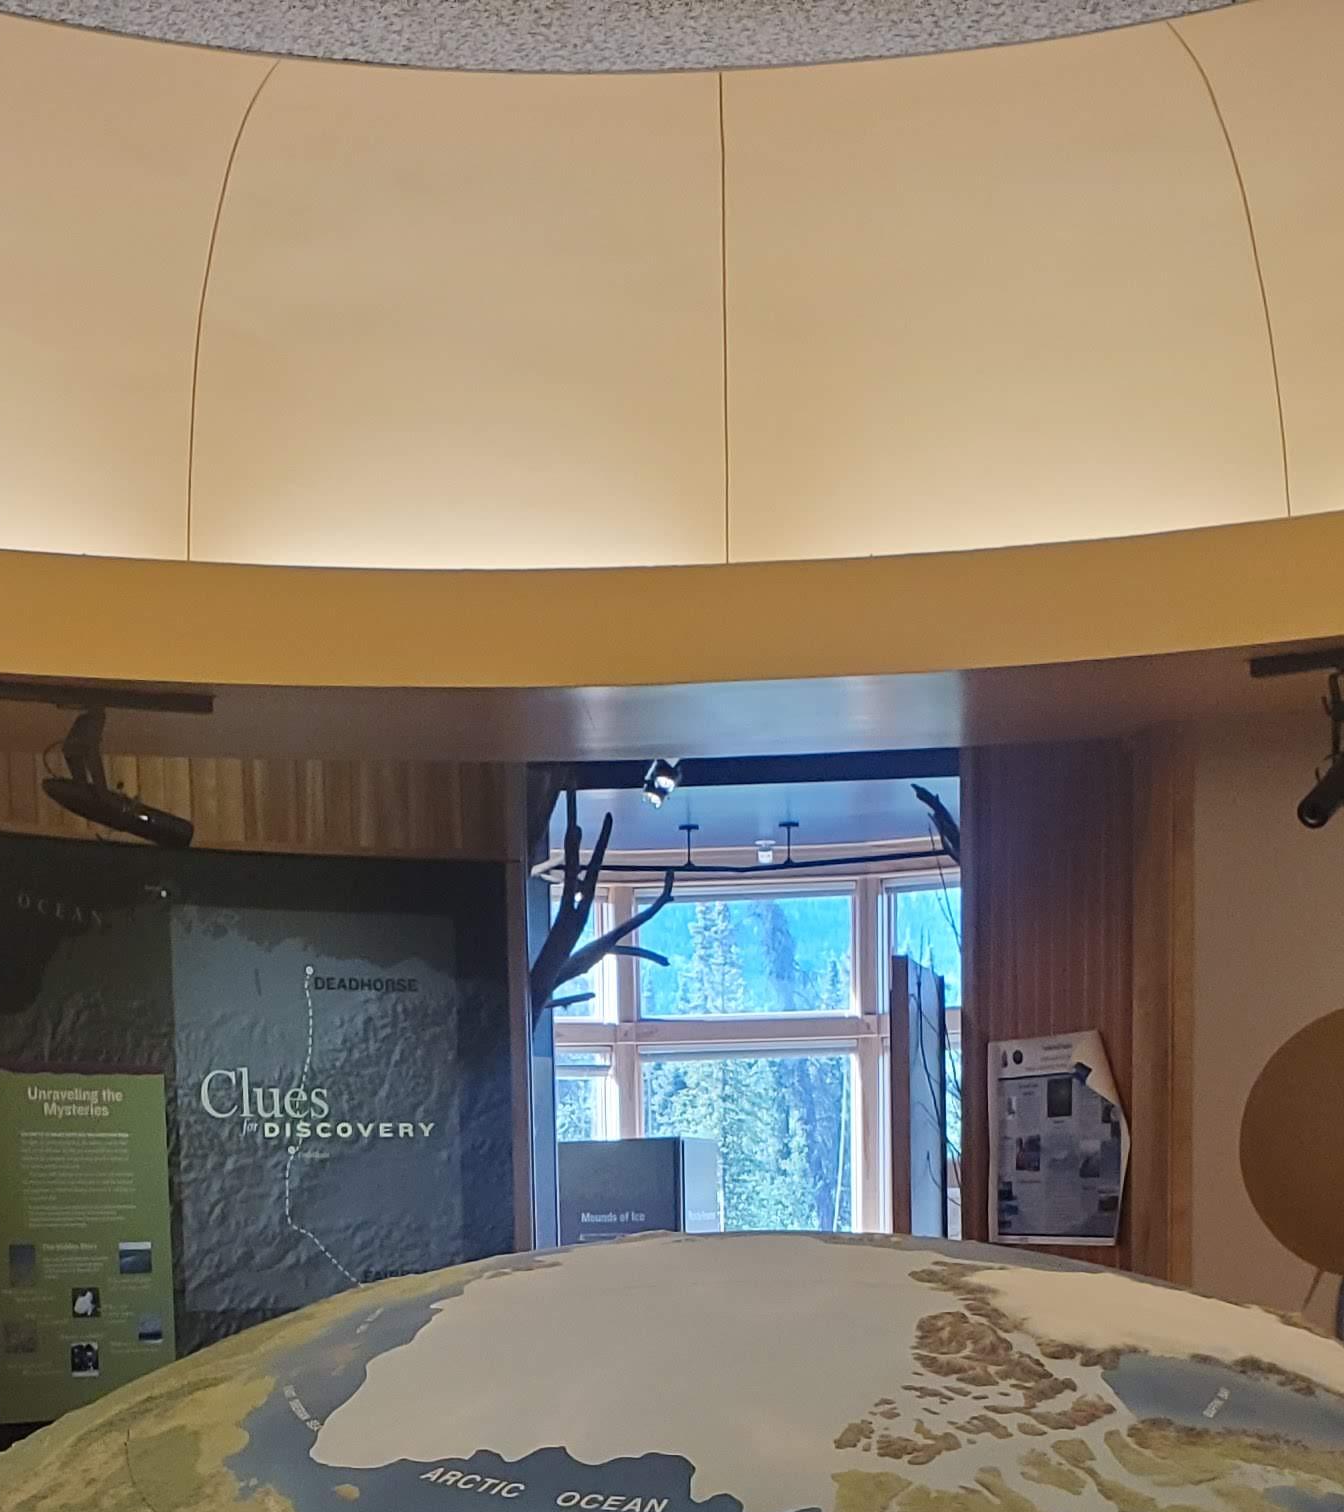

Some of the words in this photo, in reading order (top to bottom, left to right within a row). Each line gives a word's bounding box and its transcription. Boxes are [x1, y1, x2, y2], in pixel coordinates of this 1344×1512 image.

[313, 977, 419, 993] DEADHORSE
[27, 1086, 99, 1103] Unraveling
[102, 1088, 124, 1102] the
[201, 1066, 330, 1119] Clues
[43, 1102, 110, 1119] Mysteries
[264, 1122, 436, 1138] DISCOVERY
[581, 1211, 617, 1223] Mounds
[619, 1211, 629, 1222] of
[631, 1211, 645, 1222] Ice
[420, 1467, 525, 1498] ARCTIC
